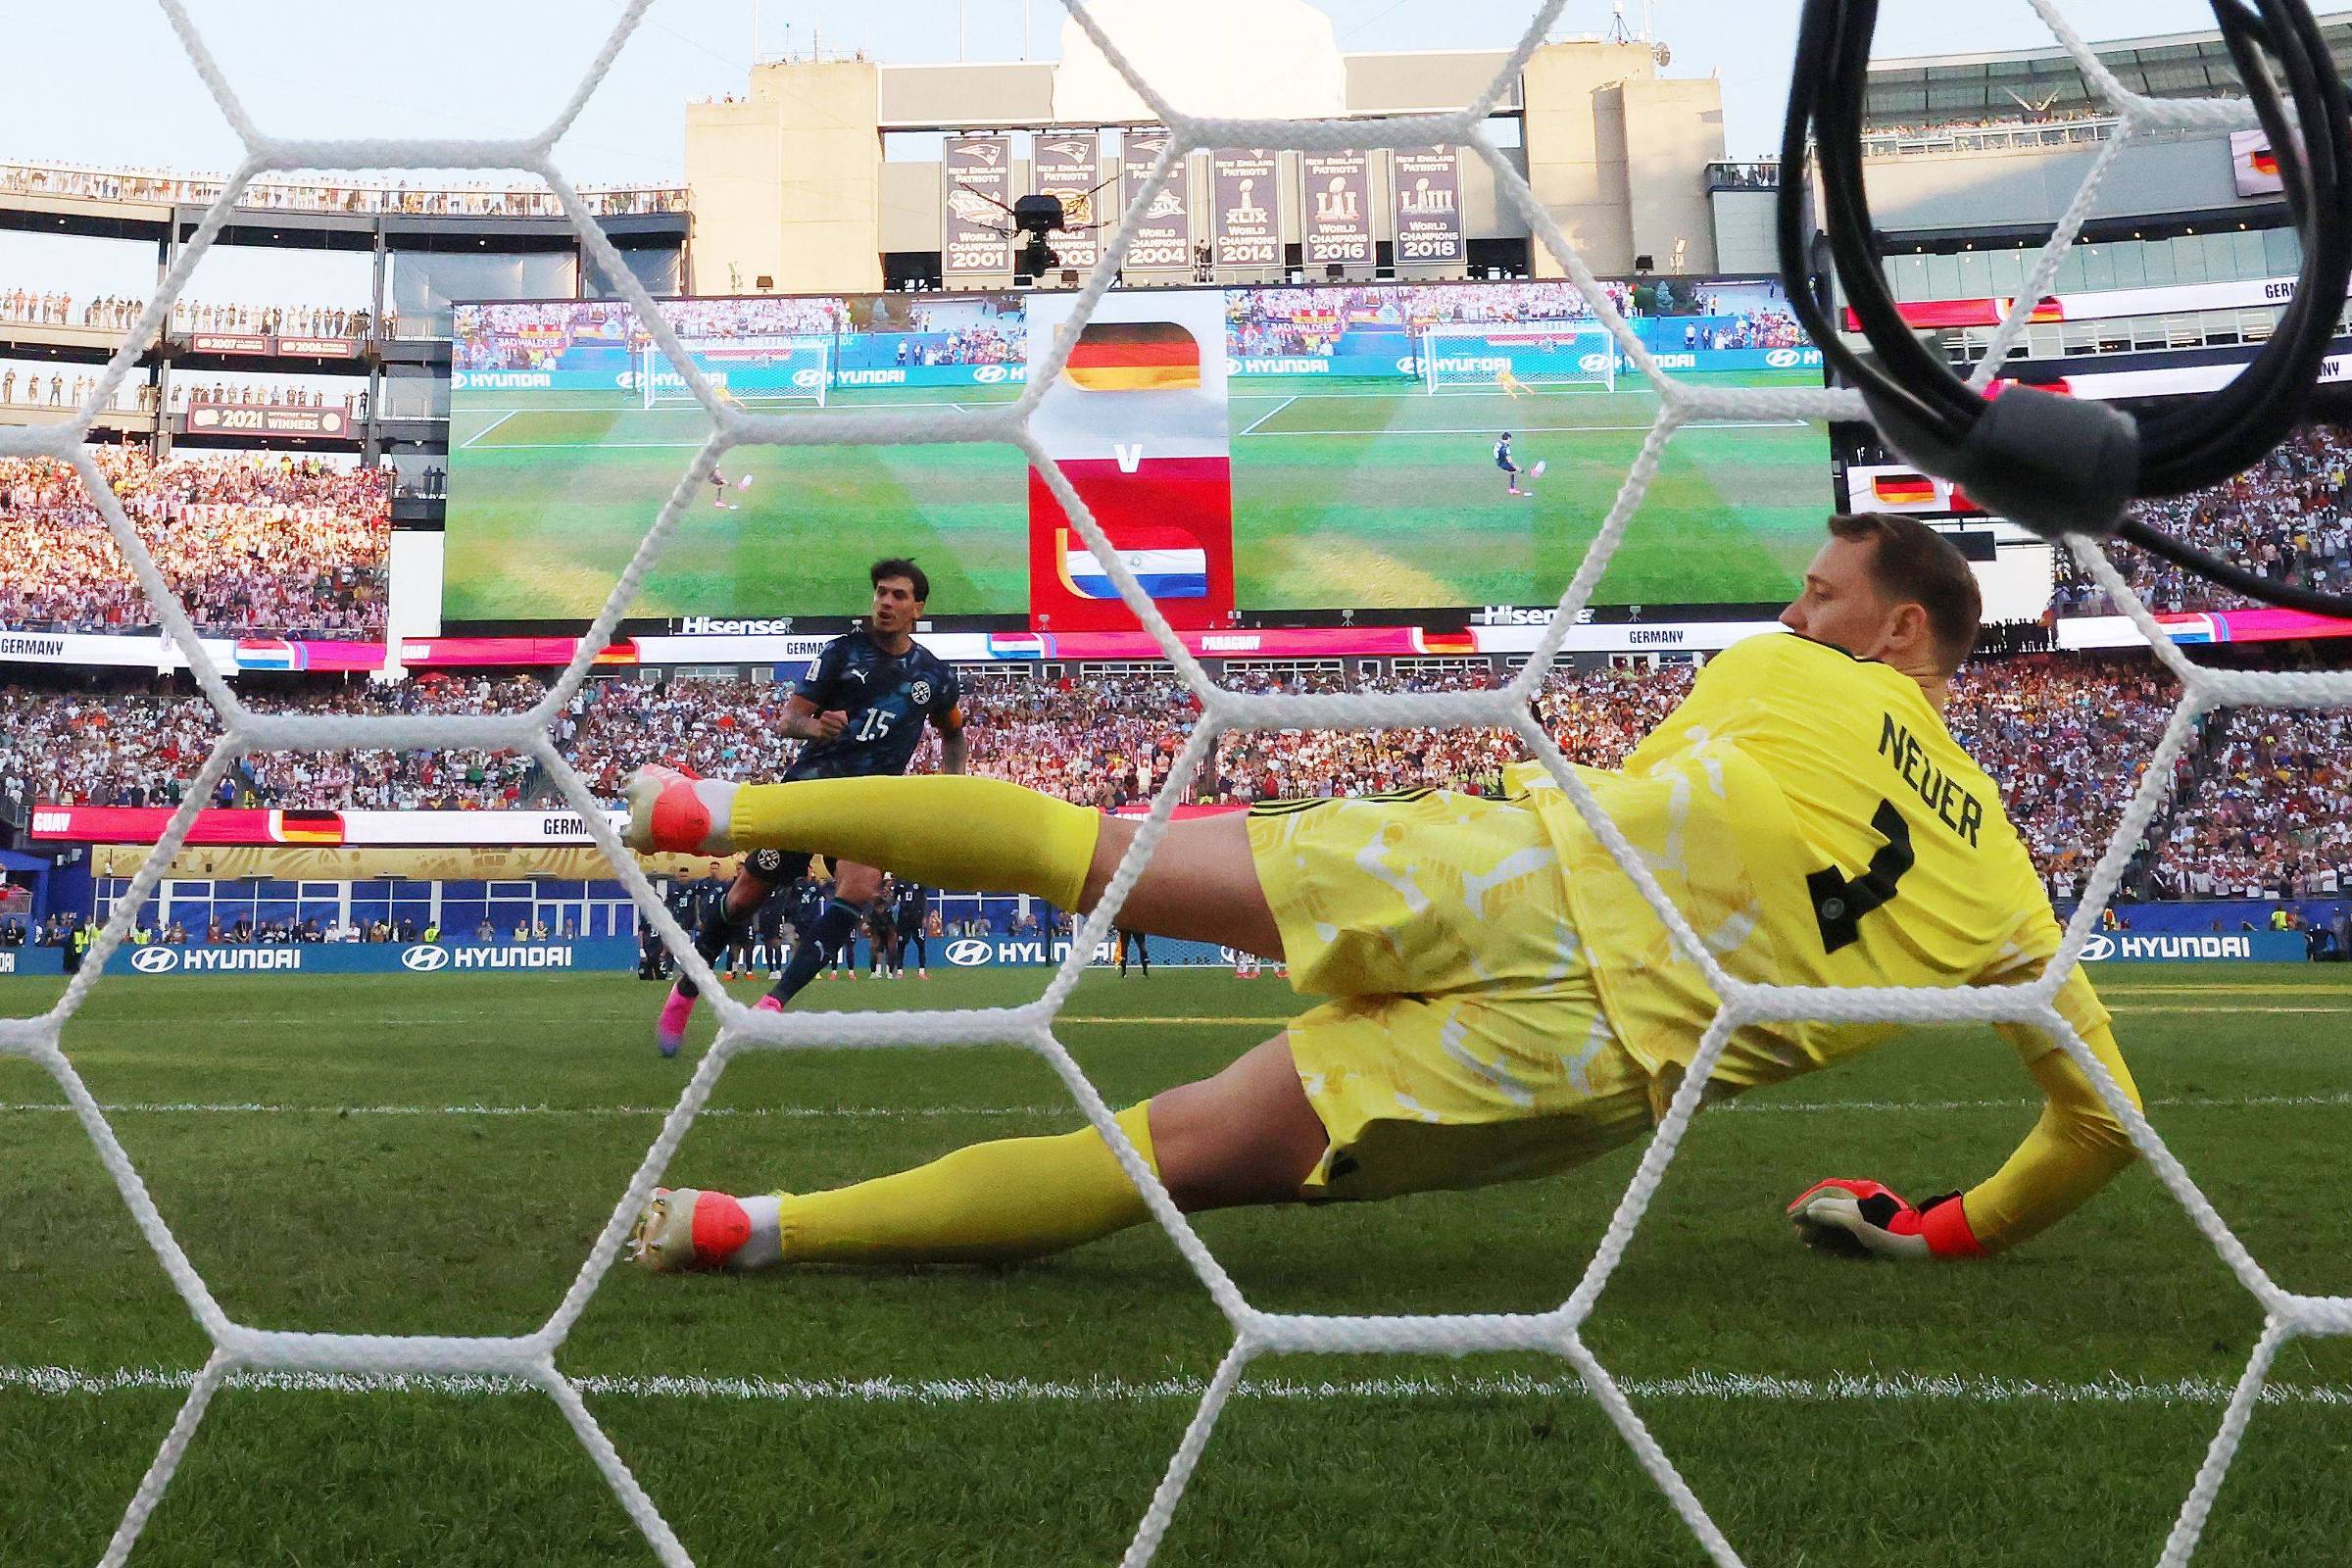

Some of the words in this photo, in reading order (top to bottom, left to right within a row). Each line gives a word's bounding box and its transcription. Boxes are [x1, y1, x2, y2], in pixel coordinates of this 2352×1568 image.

[1222, 168, 1268, 177] PATRIOTS
[1312, 166, 1359, 174] PATRIOTS
[1402, 163, 1449, 172] PATRIOTS
[955, 174, 1001, 183] PATRIOTS
[1044, 172, 1089, 181] PATRIOTS
[1225, 212, 1269, 224] XLIX
[1139, 228, 1176, 238] WORLD
[1228, 226, 1266, 235] WORLD
[1318, 224, 1357, 233] WORLD
[1408, 221, 1447, 231] WORLD
[959, 232, 997, 242] WORLD
[1049, 230, 1086, 240] WORLD
[1218, 236, 1278, 245] CHAMPIONS
[1308, 234, 1368, 243] CHAMPIONS
[1398, 231, 1459, 241] CHAMPIONS
[949, 243, 1007, 252] CHAMPIONS
[1222, 246, 1275, 262] 2014
[1313, 244, 1365, 260] 2016
[1403, 241, 1456, 257] 2018
[952, 252, 1004, 268] 2001
[1057, 250, 1096, 266] 003
[1129, 248, 1187, 264] 2004
[1245, 360, 1329, 373] HYUNDAI
[1615, 354, 1695, 368] HYNDAI
[469, 373, 551, 388] HYUNDAI
[221, 410, 264, 428] 2021
[268, 418, 319, 430] WINNERS
[1484, 605, 1592, 625] Hisene
[682, 616, 785, 635] Hisense
[1200, 635, 1261, 651] PARAGUAY
[1629, 630, 1684, 644] GERMANY
[1, 639, 64, 656] GERMANY
[787, 642, 825, 655] GERMA
[856, 708, 896, 742] 15
[1878, 711, 1983, 849] NEUER
[999, 942, 1116, 963] HYUNAI
[2122, 936, 2251, 958] HYUNDAI
[183, 949, 301, 969] HYUNDAI
[455, 946, 572, 967] HYUNDAI
